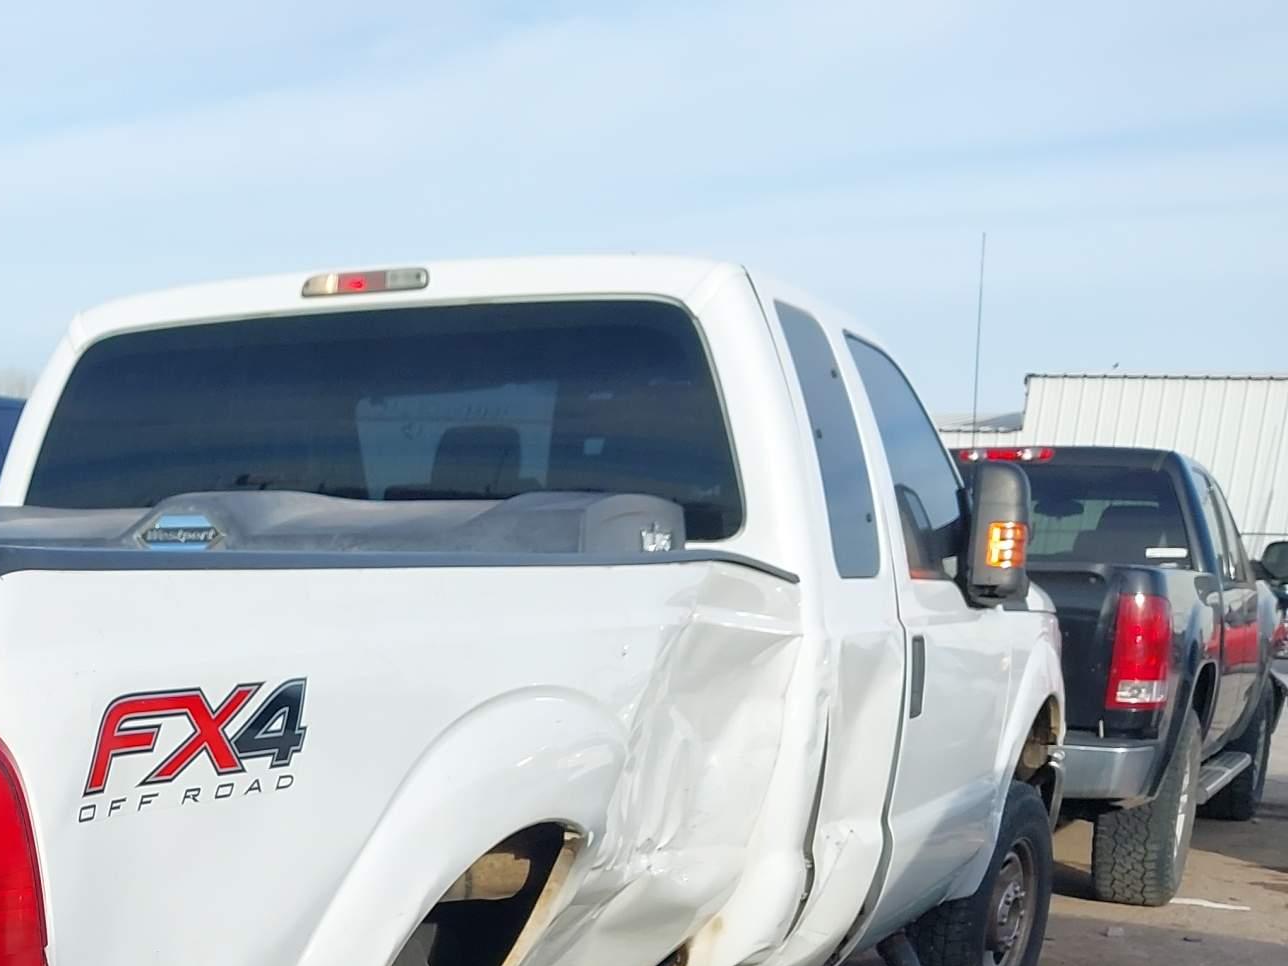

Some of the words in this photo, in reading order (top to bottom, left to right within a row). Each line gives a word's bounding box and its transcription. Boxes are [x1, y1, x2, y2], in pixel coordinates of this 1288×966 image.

[82, 677, 308, 798] FX4
[78, 793, 159, 823] OFF
[181, 774, 295, 805] ROAD
